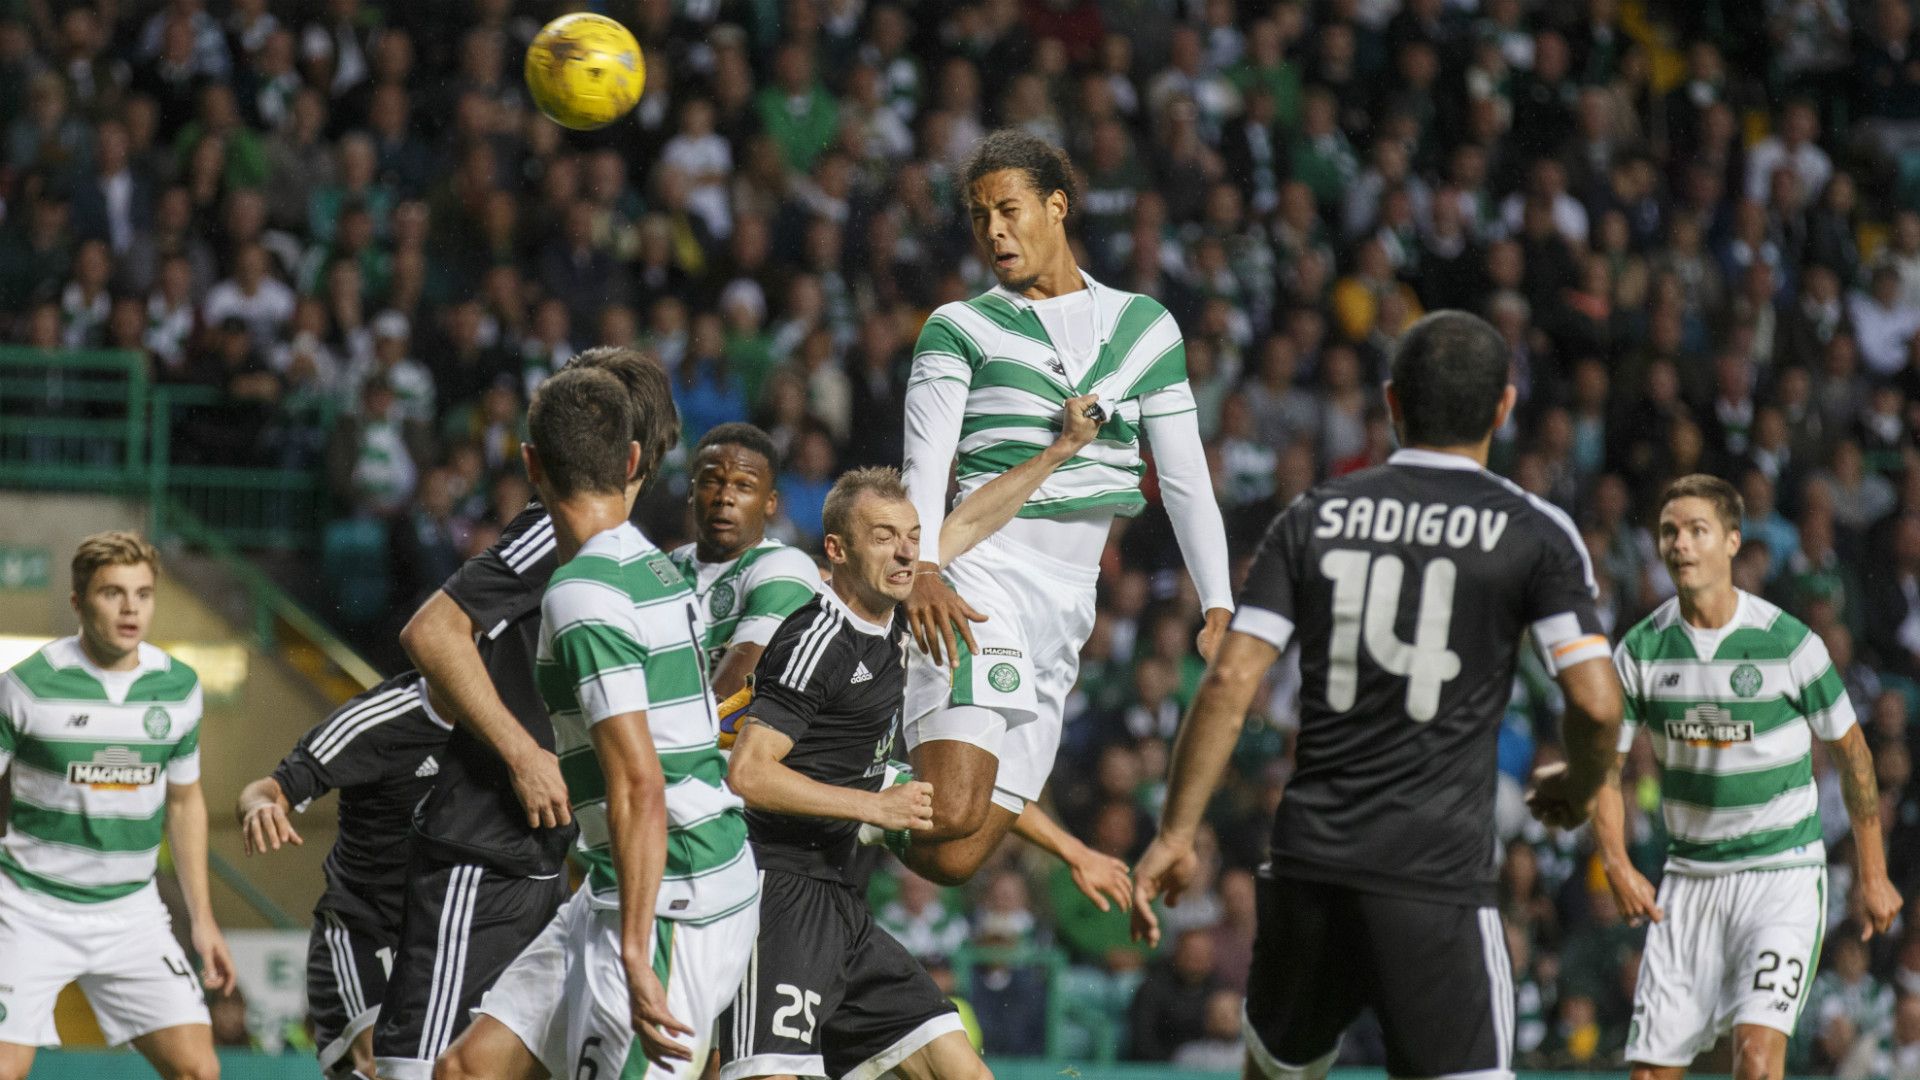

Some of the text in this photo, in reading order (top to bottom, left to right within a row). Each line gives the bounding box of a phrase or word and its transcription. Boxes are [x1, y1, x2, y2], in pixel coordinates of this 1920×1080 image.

[1314, 496, 1509, 552] SADIGOV
[984, 647, 1021, 658] MAGNERS
[1319, 548, 1462, 723] 14
[74, 764, 154, 784] MAGNERS
[1753, 950, 1803, 999] 23
[771, 983, 822, 1045] 25
